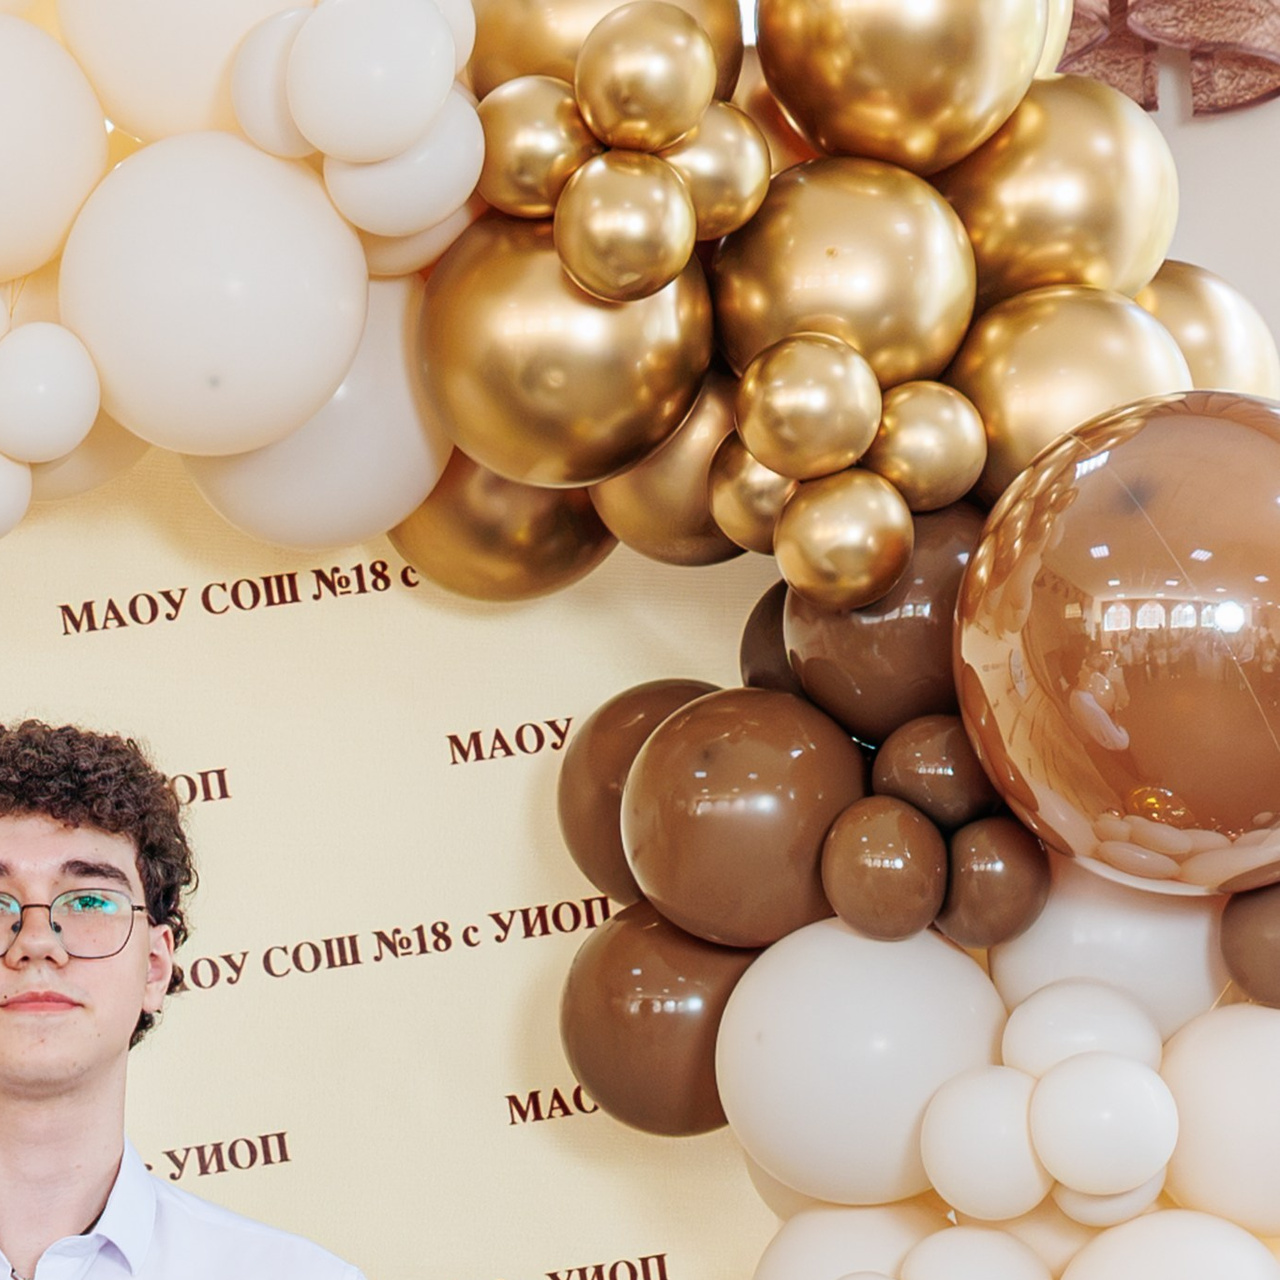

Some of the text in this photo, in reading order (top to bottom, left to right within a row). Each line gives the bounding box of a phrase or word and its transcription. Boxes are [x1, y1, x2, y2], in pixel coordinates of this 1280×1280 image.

[58, 560, 421, 636] МАОУ СОШ №18 с
[446, 717, 573, 765] МАОУ
[171, 768, 231, 805] ОП
[186, 895, 611, 994] ОУ СОШ №18 с УИОП
[505, 1085, 599, 1126] МАО
[162, 1131, 291, 1181] УИОП
